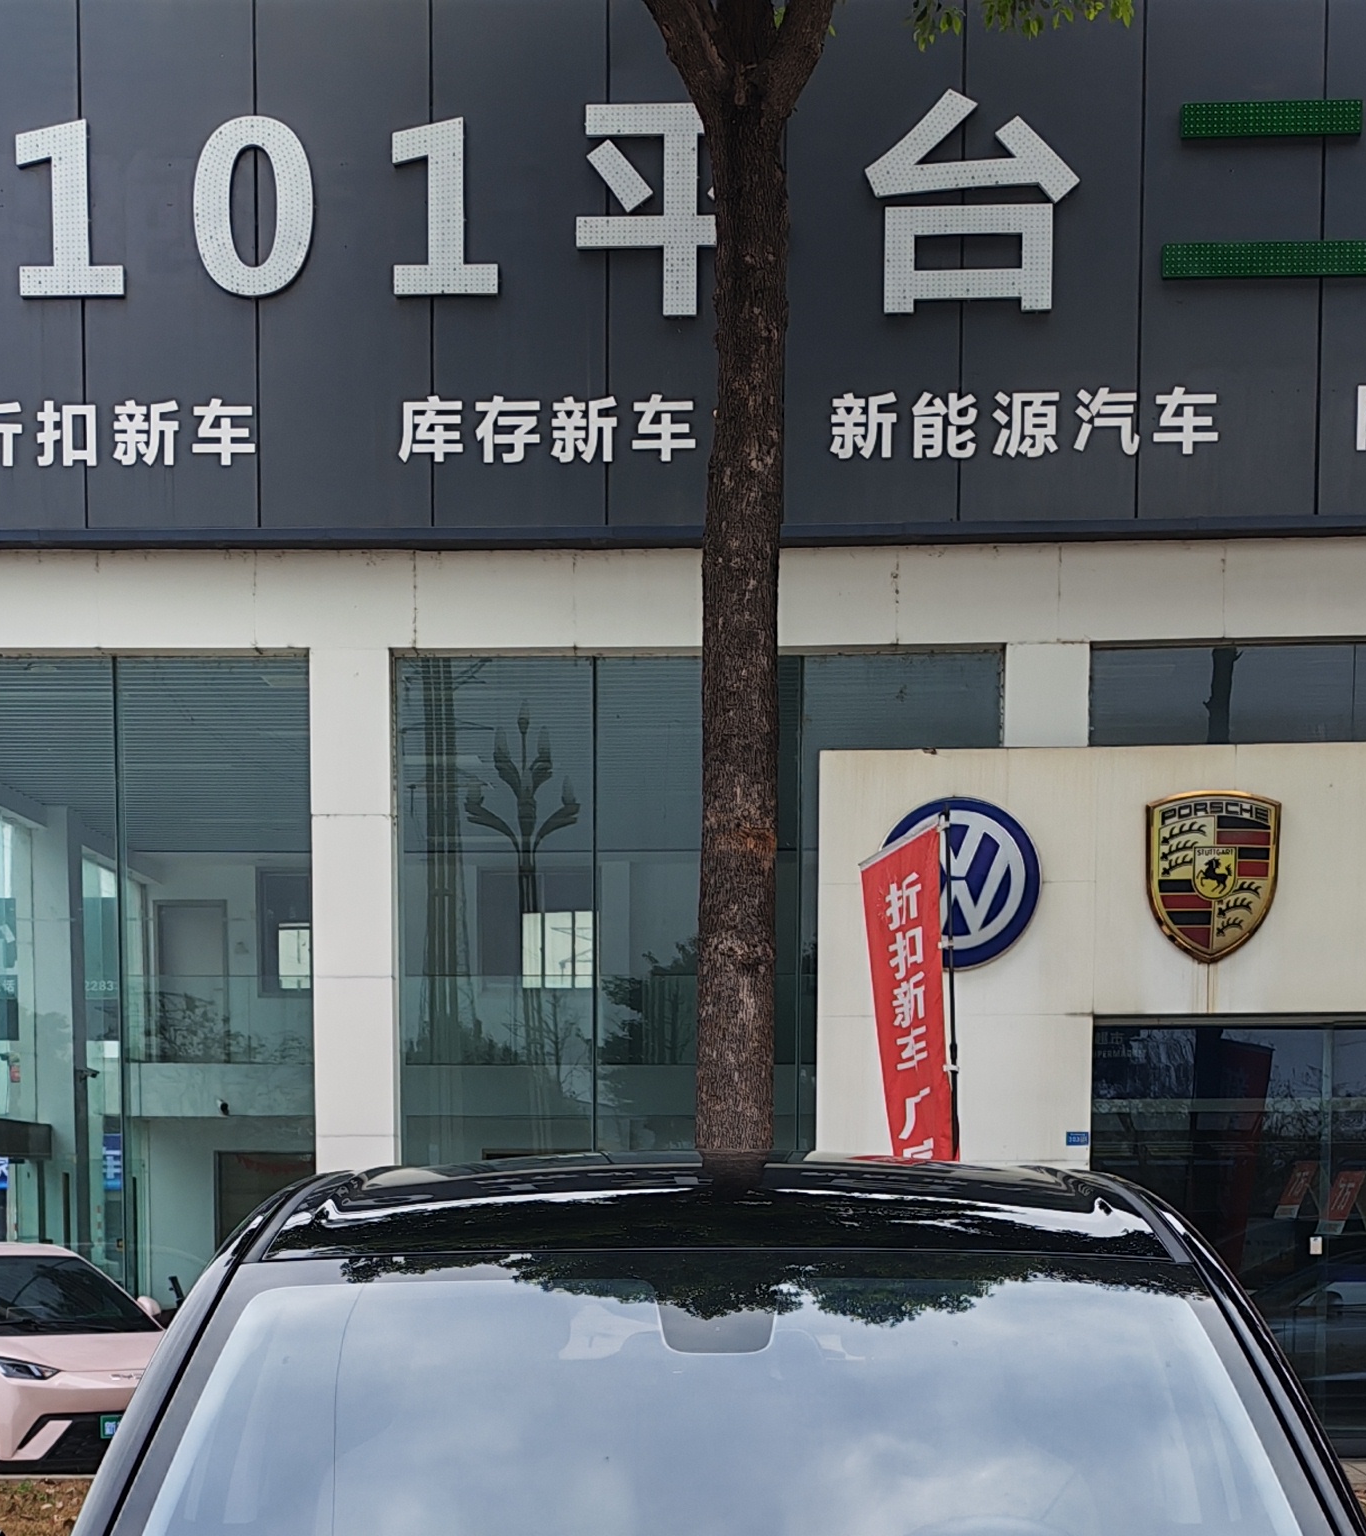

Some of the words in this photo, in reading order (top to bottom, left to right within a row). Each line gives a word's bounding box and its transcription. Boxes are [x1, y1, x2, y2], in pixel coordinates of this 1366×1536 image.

[398, 394, 697, 464] 库存新车
[829, 385, 1220, 460] 新能源汽车
[1161, 801, 1269, 826] PORSCHE
[1196, 848, 1234, 857] STUTTGART
[885, 871, 928, 1071] 折扣新车
